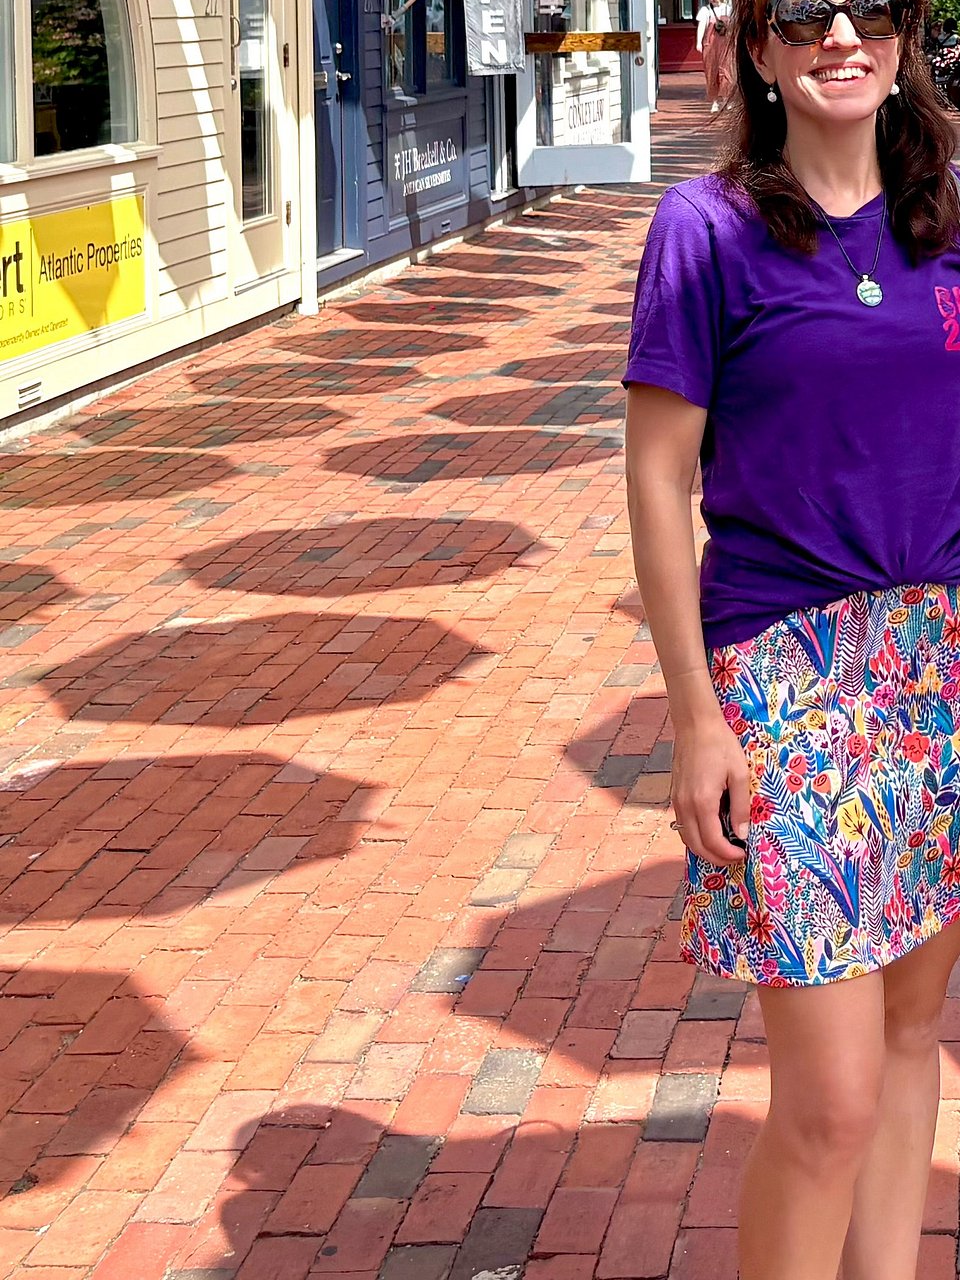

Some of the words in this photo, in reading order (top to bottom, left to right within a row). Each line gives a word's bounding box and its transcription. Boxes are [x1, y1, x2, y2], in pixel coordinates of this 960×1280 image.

[402, 149, 411, 181] JH
[413, 141, 439, 172] Breakell
[38, 247, 84, 284] Atlantic
[87, 233, 142, 272] Properties
